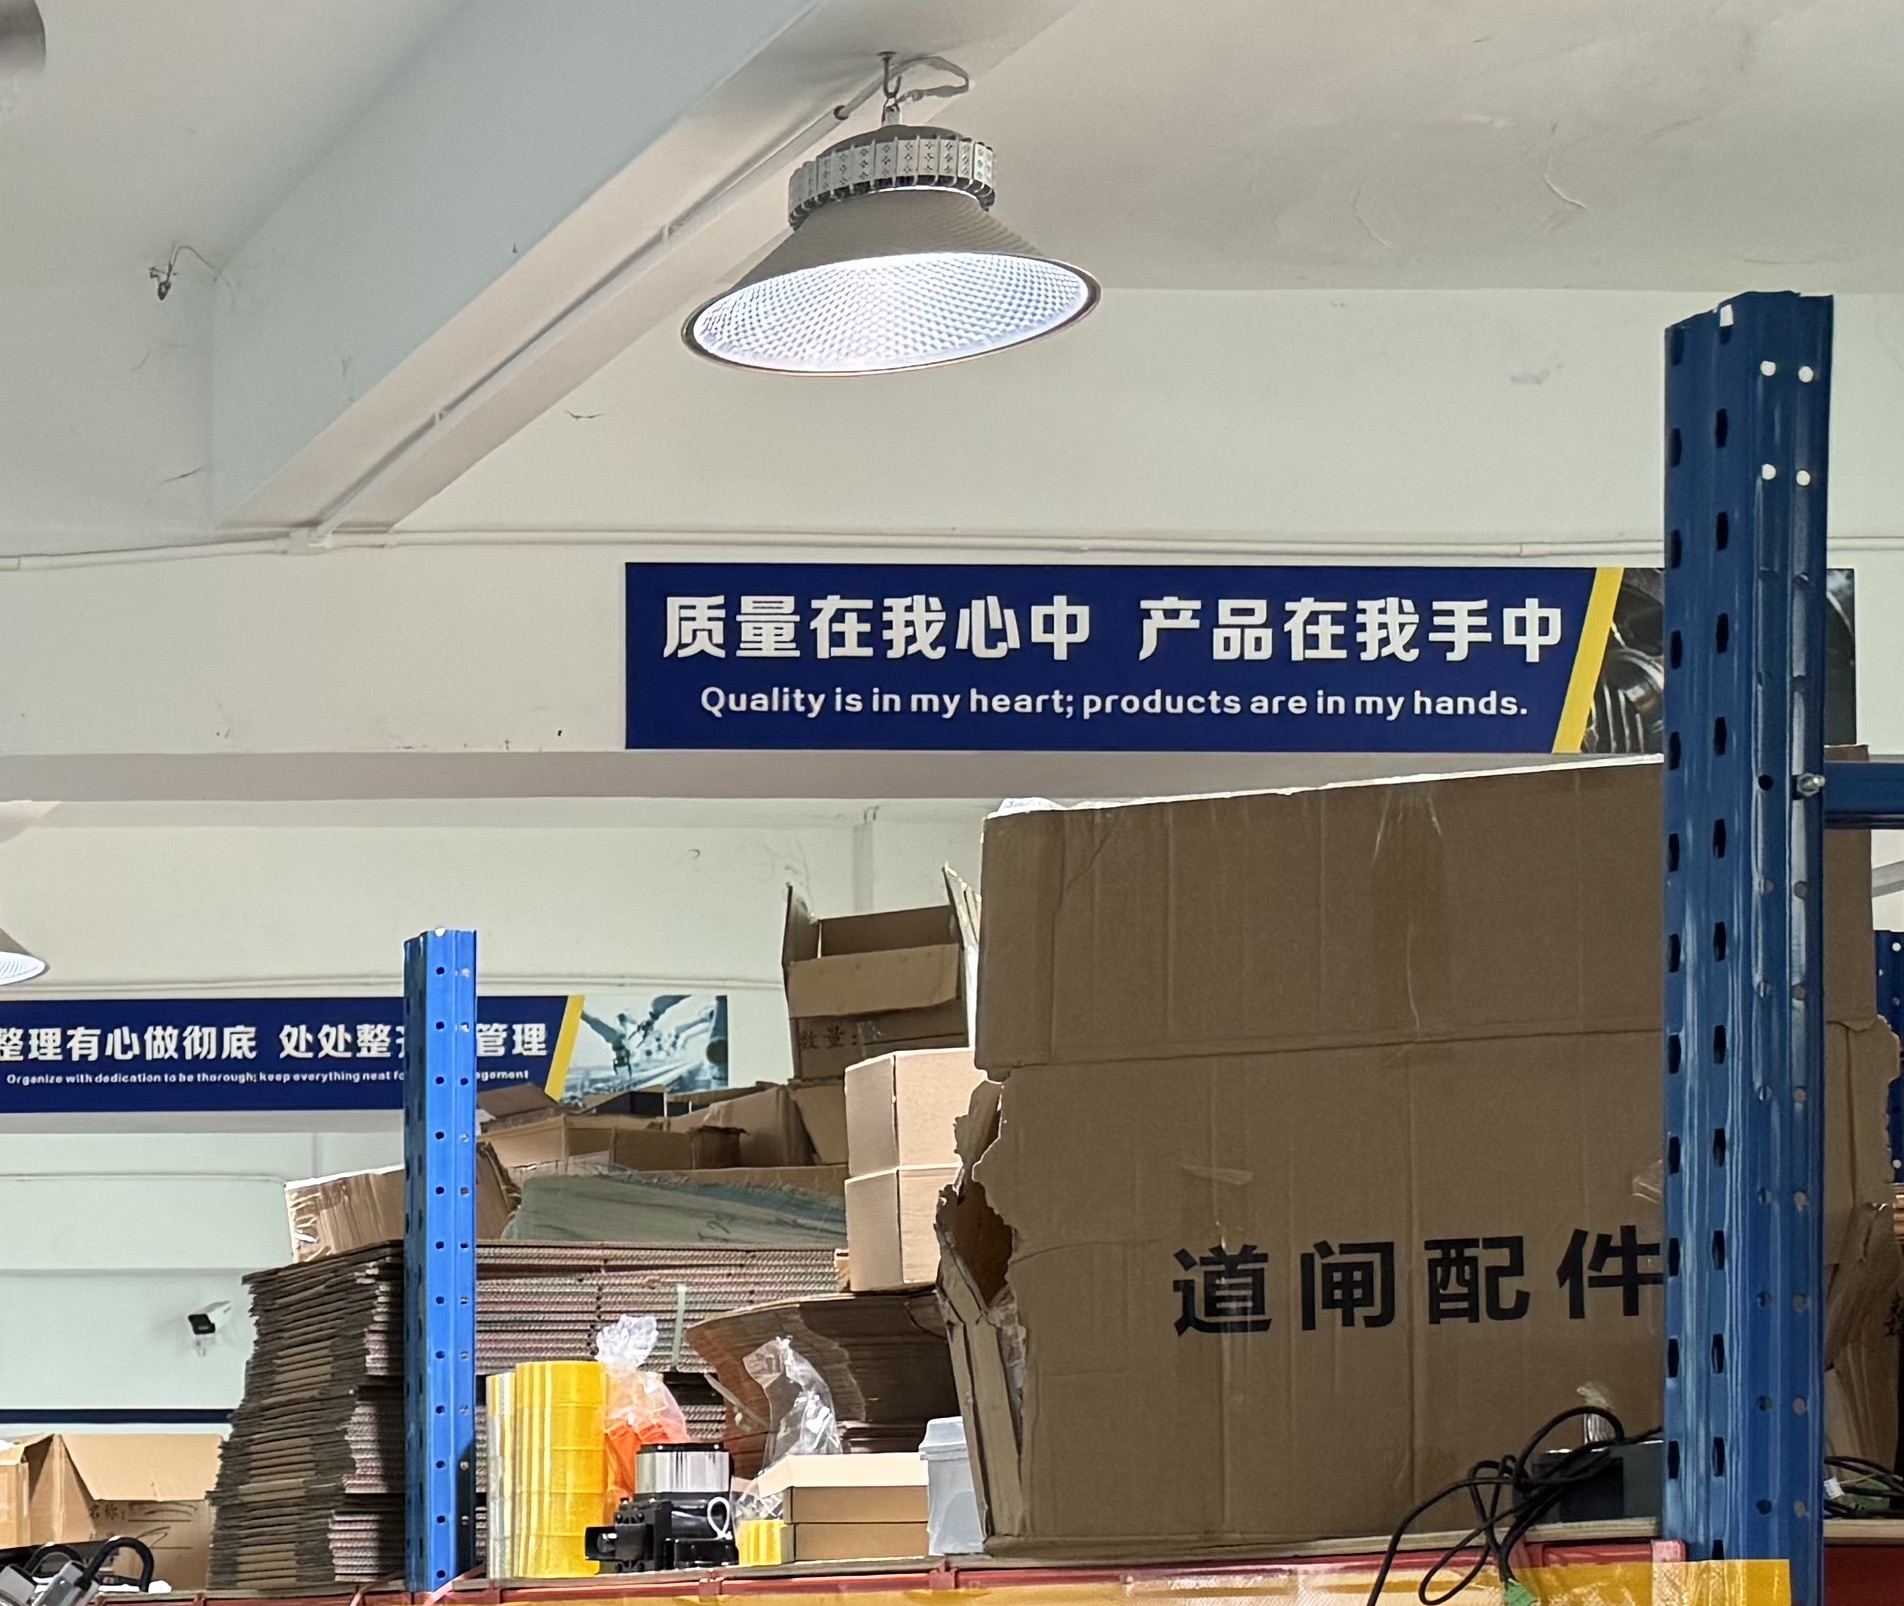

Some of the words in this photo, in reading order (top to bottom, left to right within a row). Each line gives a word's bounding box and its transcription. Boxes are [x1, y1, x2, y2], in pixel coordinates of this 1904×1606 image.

[664, 595, 1089, 662] 质量在我心中
[1139, 596, 1561, 663] 产品在我手中
[701, 686, 826, 719] Quality
[835, 686, 863, 713] is
[872, 687, 901, 713] in
[910, 693, 961, 719] my
[970, 688, 1074, 719] heart;
[1083, 689, 1242, 720] products
[1250, 695, 1308, 715] are
[1317, 689, 1346, 715] in
[1355, 695, 1405, 721] my
[1414, 689, 1528, 716] hands.
[278, 1022, 548, 1059] 处处整管理
[1171, 1224, 1665, 1337] 道闸配件
